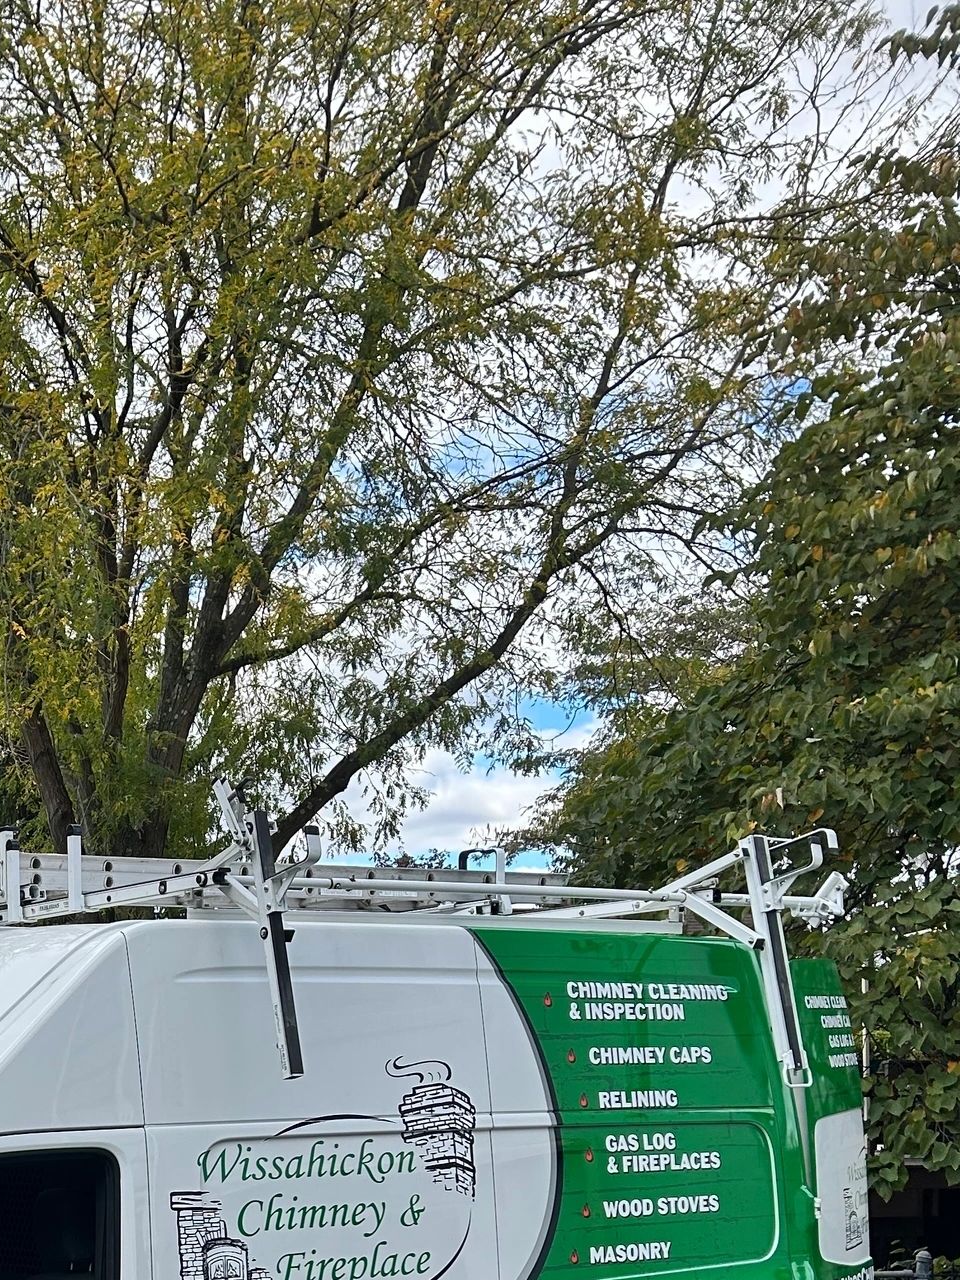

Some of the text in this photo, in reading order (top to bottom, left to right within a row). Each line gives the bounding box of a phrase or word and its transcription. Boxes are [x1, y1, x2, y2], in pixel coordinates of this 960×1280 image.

[566, 981, 728, 1001] CHIMNEY CLEANING
[569, 1002, 685, 1021] & INSPECTION
[589, 1046, 712, 1065] CHIMNEY CAPS
[598, 1089, 678, 1109] RELINING
[605, 1132, 677, 1152] GAS LOG
[196, 1138, 417, 1184] Wissahickon
[607, 1151, 721, 1174] & FIREPLACES
[237, 1193, 426, 1237] Chimney &
[603, 1194, 720, 1218] WOOD STOVES
[589, 1241, 672, 1264] MASONRY
